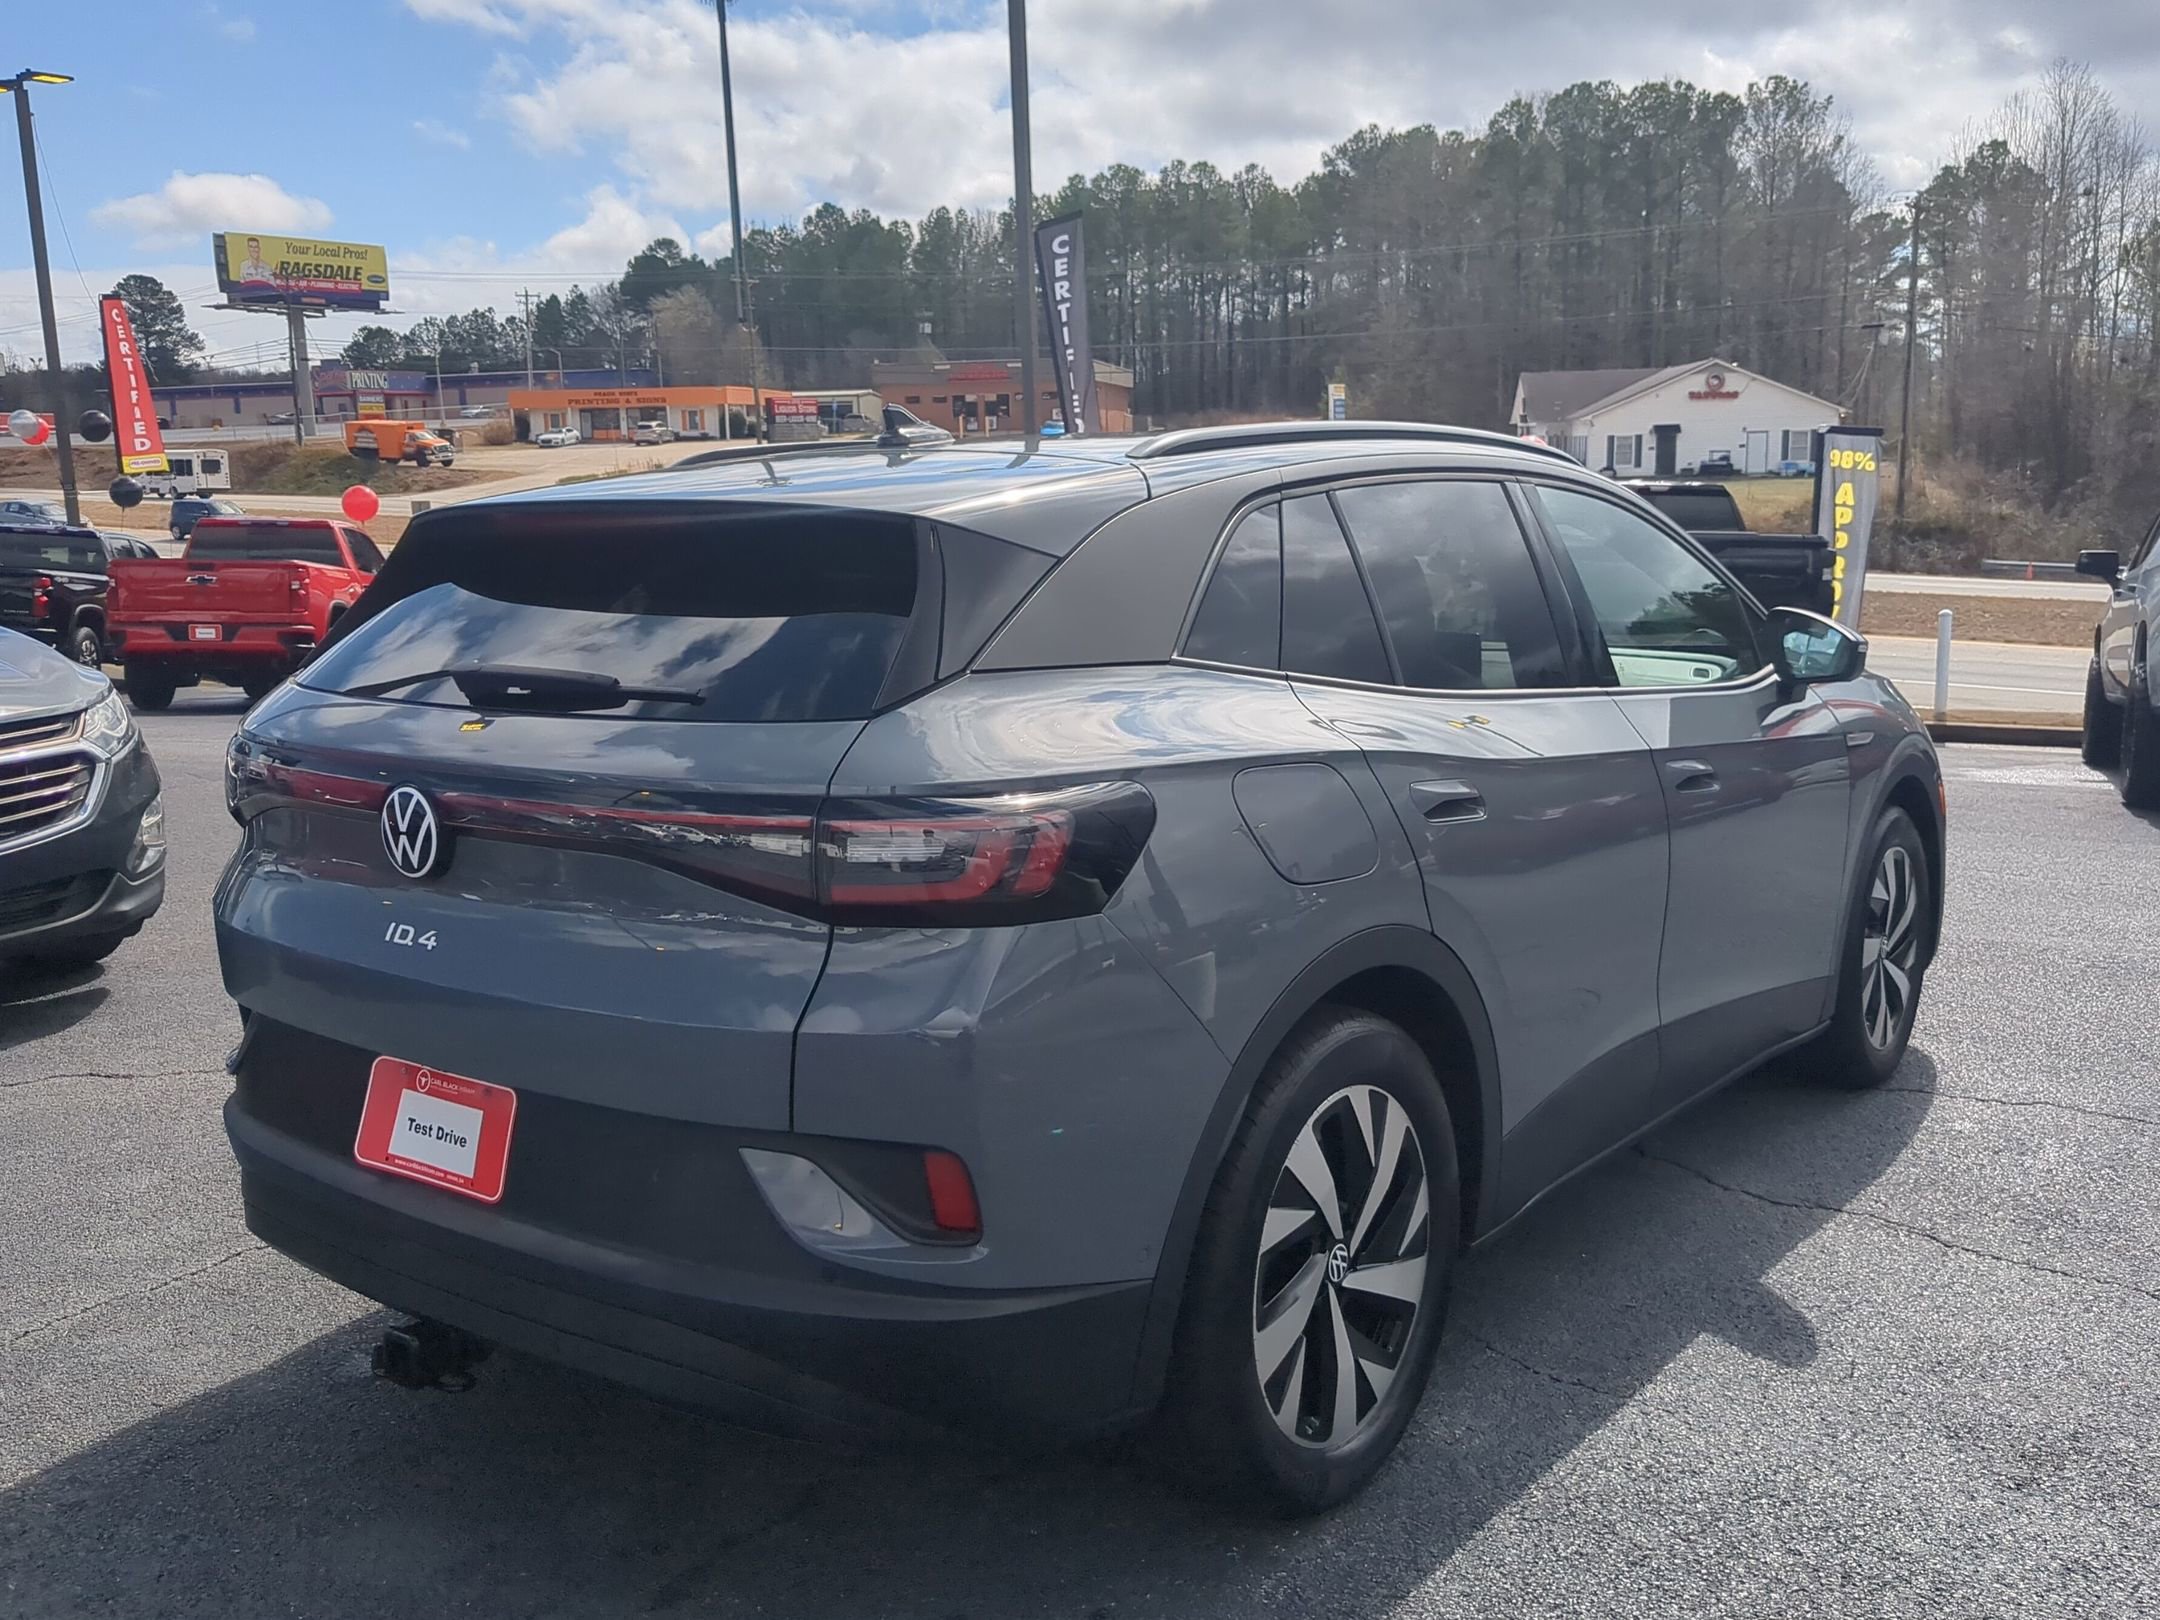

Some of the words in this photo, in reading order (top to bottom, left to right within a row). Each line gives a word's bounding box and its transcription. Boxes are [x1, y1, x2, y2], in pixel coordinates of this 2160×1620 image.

[285, 241, 310, 255] Your
[313, 244, 340, 259] Local
[343, 247, 368, 261] Pros!
[279, 260, 363, 282] RAGSDALE
[111, 308, 152, 452] CERTIFIED
[351, 372, 388, 389] PRINTING
[1830, 448, 1876, 472] 98%
[442, 1081, 459, 1091] BLACK
[408, 1117, 433, 1138] Test
[436, 1125, 467, 1148] Drive
